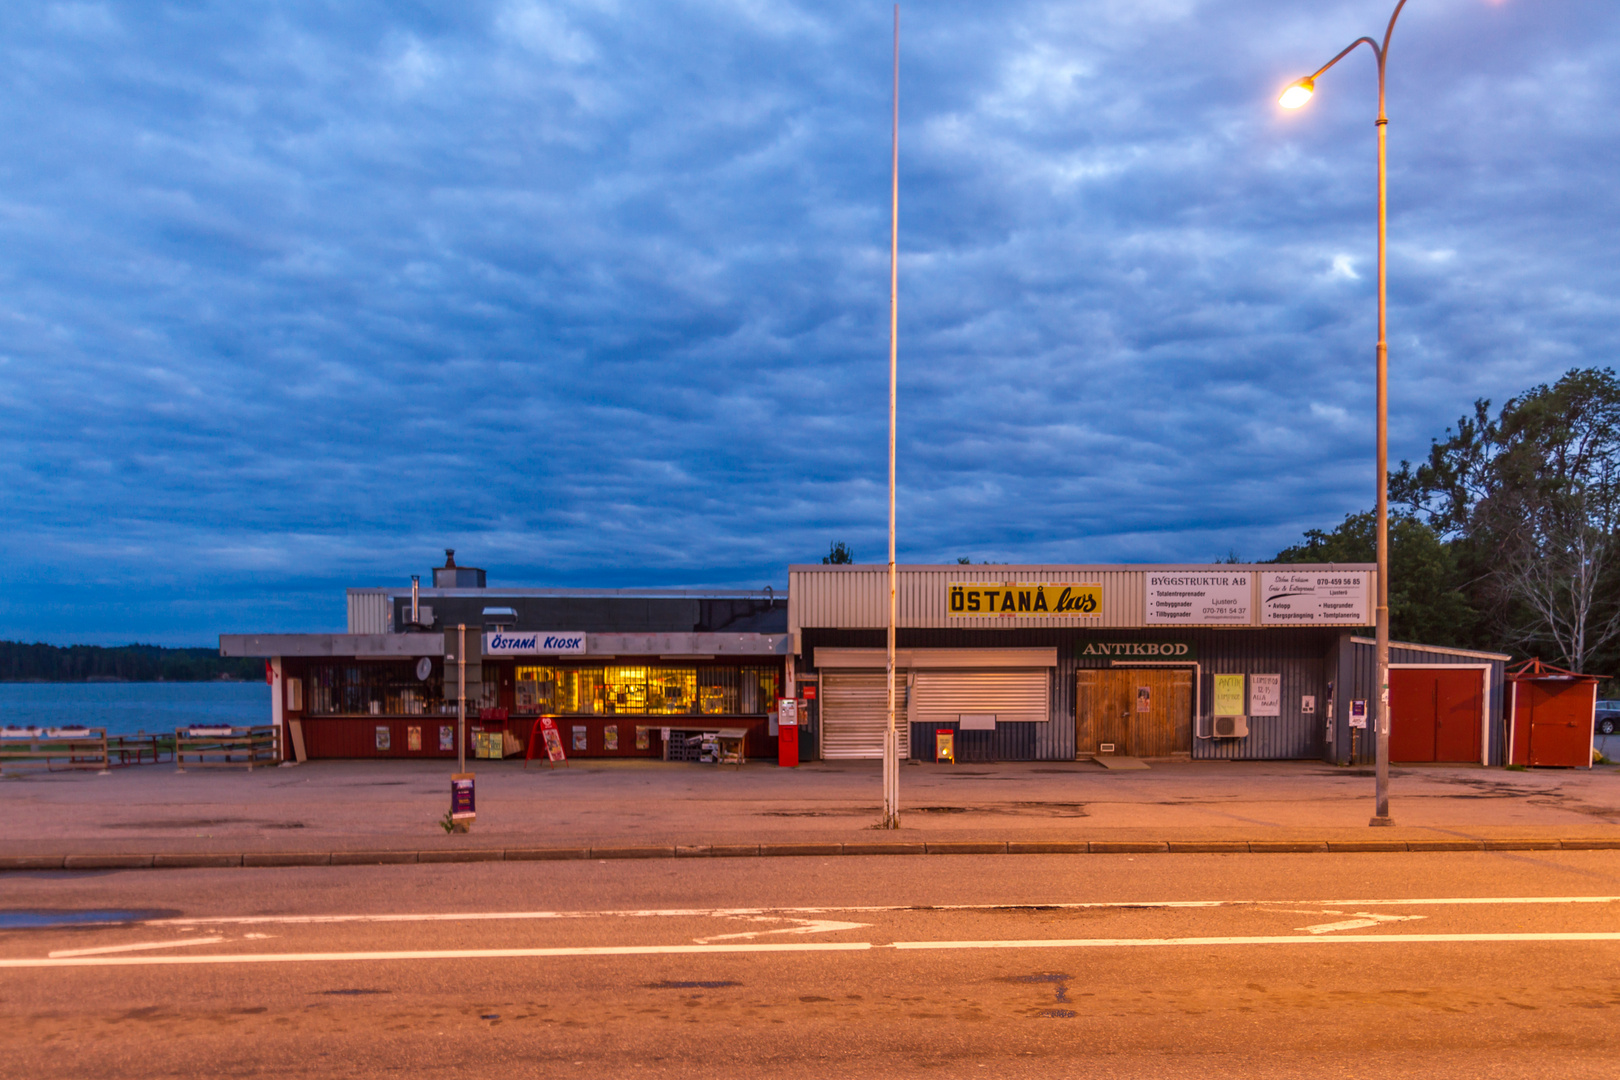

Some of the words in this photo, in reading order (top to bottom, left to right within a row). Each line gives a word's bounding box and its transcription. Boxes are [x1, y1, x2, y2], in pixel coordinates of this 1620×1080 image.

[1151, 577, 1229, 586] BYGGSTRUKTUR
[1232, 577, 1246, 586] AB
[1317, 578, 1342, 586] 070-459
[1343, 578, 1351, 586] 56
[1352, 578, 1360, 586] 85
[951, 586, 1048, 612] ÖSTANÅ
[1156, 611, 1191, 619] Tillbyggnader
[1272, 612, 1314, 620] Bergsprängning
[1323, 612, 1360, 620] Tomtplanering
[543, 636, 582, 648] KIOSK
[1082, 643, 1189, 656] ANTIKBOD
